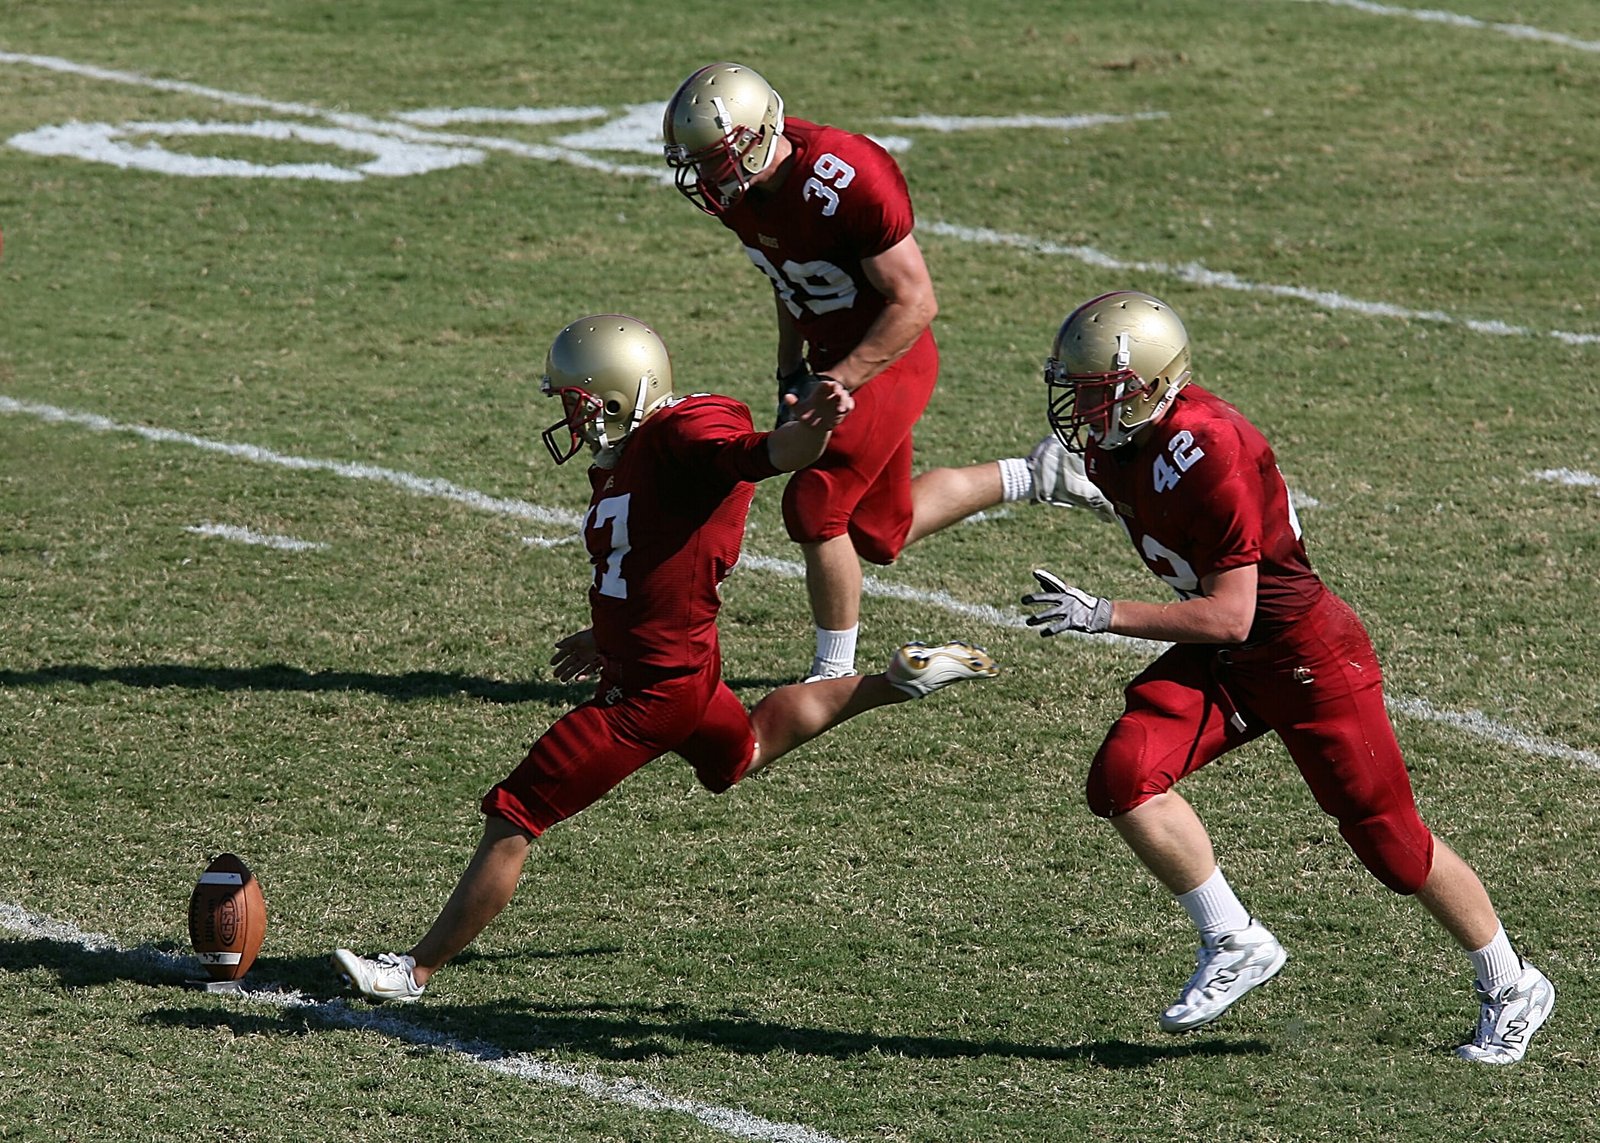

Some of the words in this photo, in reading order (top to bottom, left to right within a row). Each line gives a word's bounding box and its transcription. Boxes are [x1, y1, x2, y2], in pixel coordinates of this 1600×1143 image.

[803, 153, 856, 217] 39
[1152, 430, 1205, 493] 42
[580, 493, 632, 600] 7
[1501, 1020, 1529, 1043] N
